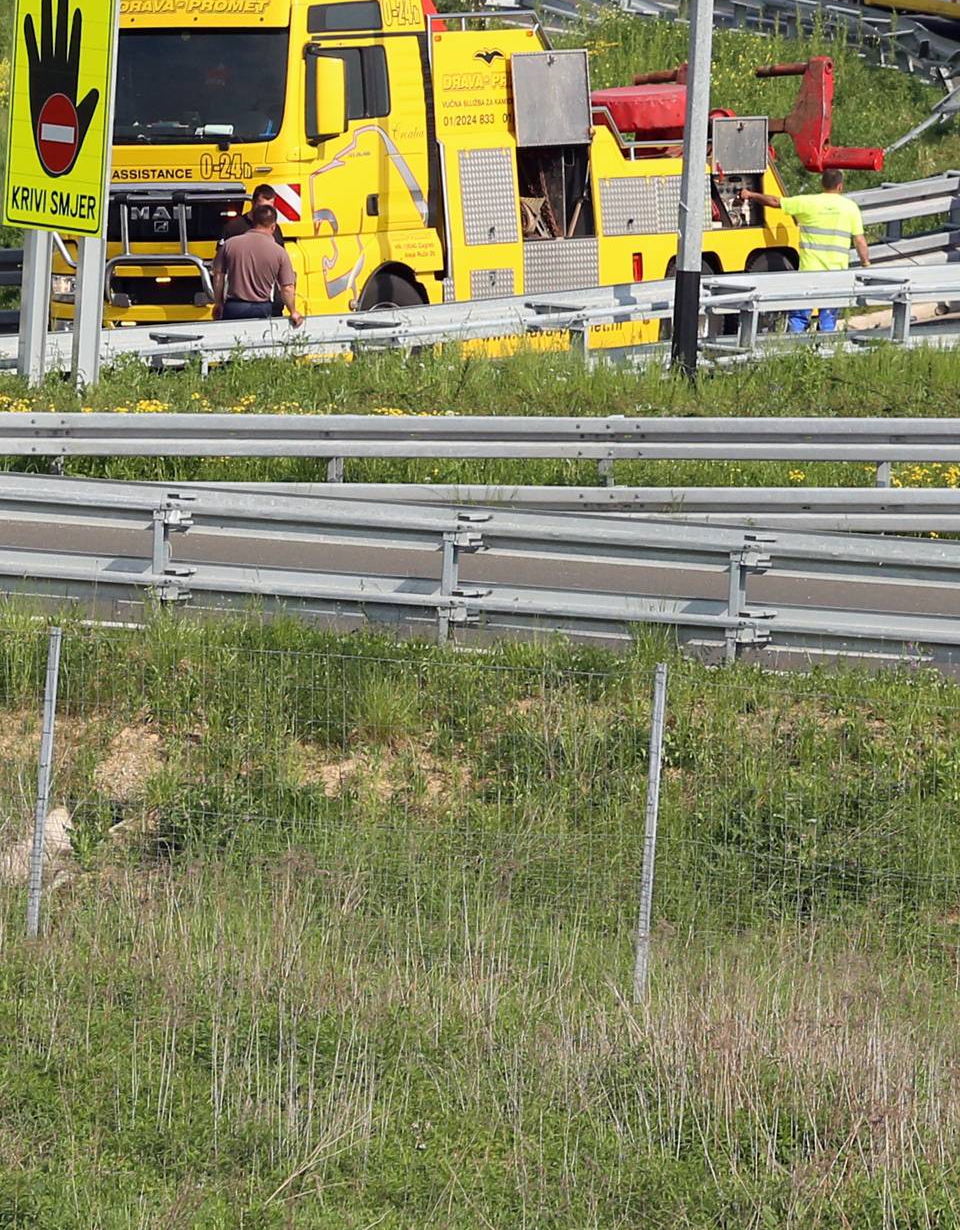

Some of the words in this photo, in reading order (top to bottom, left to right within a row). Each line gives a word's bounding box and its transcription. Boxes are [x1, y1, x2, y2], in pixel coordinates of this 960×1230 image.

[479, 113, 496, 124] 833
[112, 168, 193, 180] ASSISTANCE
[200, 152, 253, 180] 0-24h
[12, 185, 47, 214] KRIVI
[50, 190, 97, 220] SMJER
